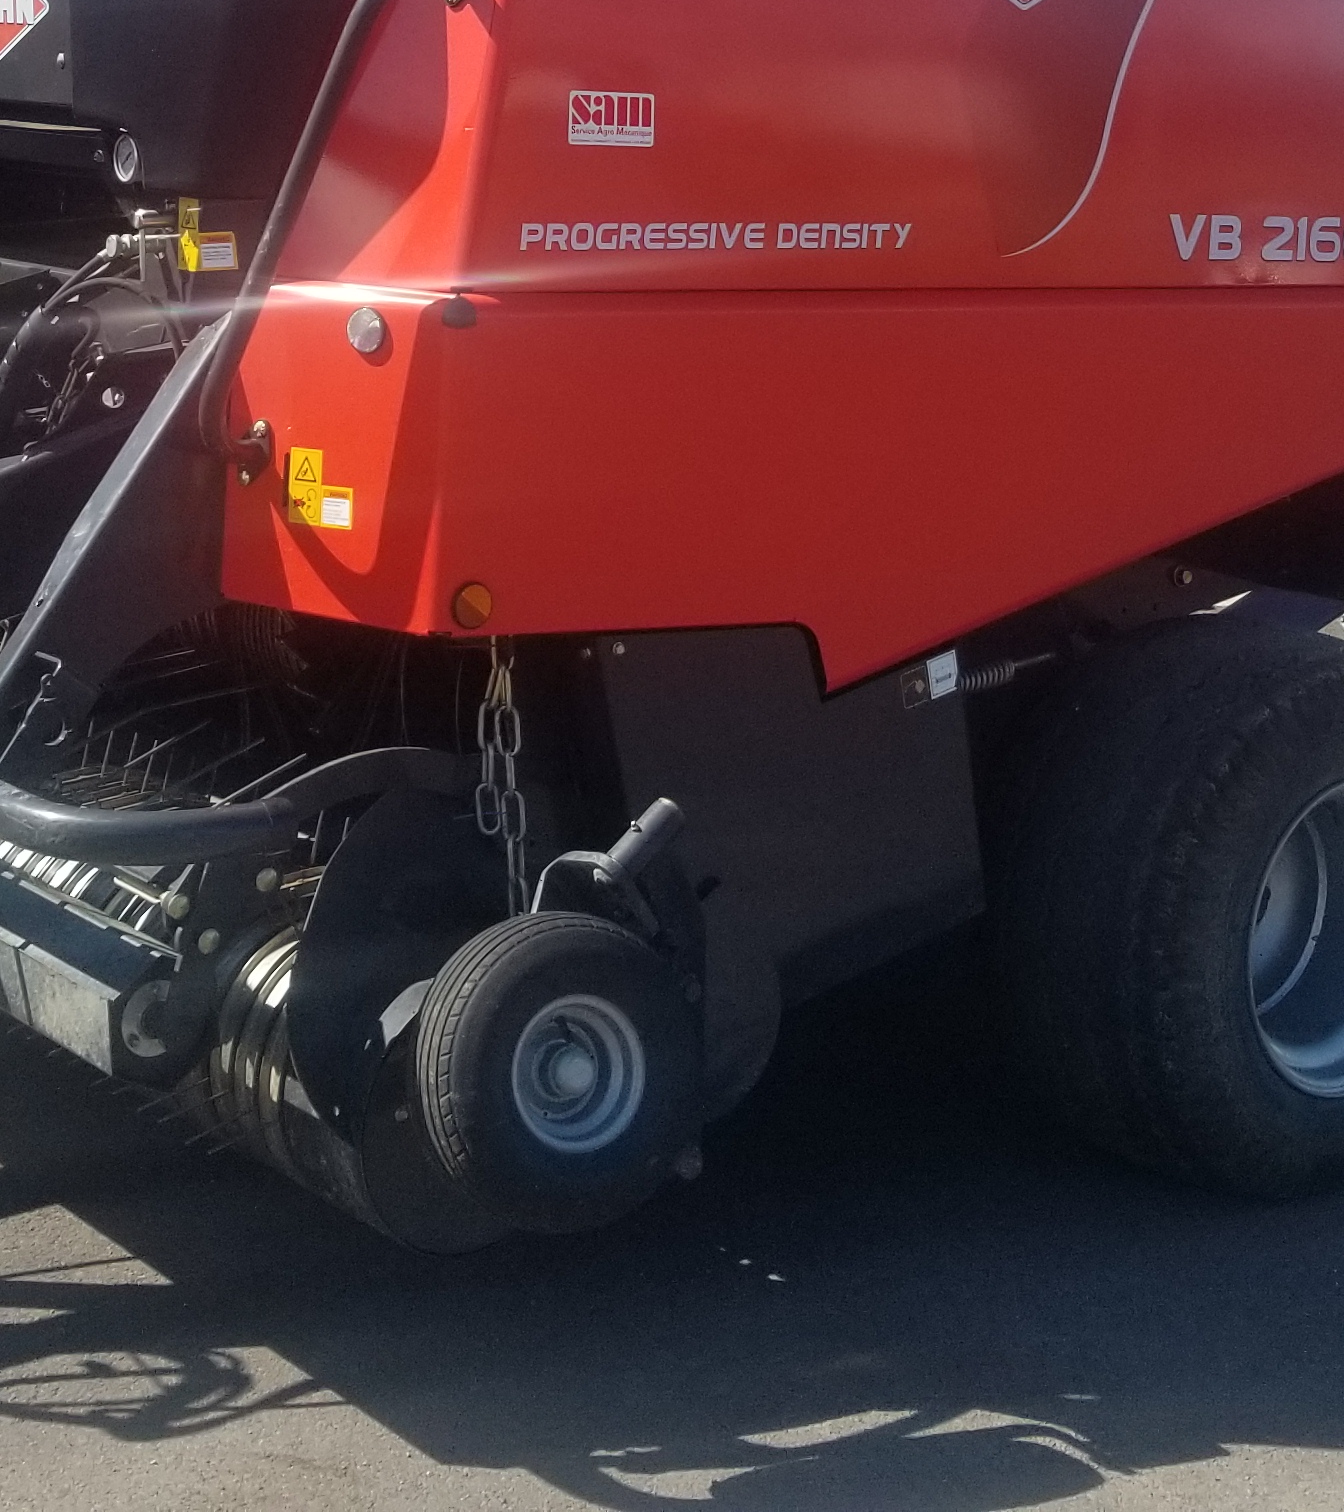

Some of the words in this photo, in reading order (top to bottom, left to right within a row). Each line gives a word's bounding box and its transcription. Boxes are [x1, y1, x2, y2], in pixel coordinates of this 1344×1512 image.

[519, 222, 766, 251] PROGRESSIVE
[776, 223, 912, 250] DENSITY
[1169, 213, 1242, 261] VB
